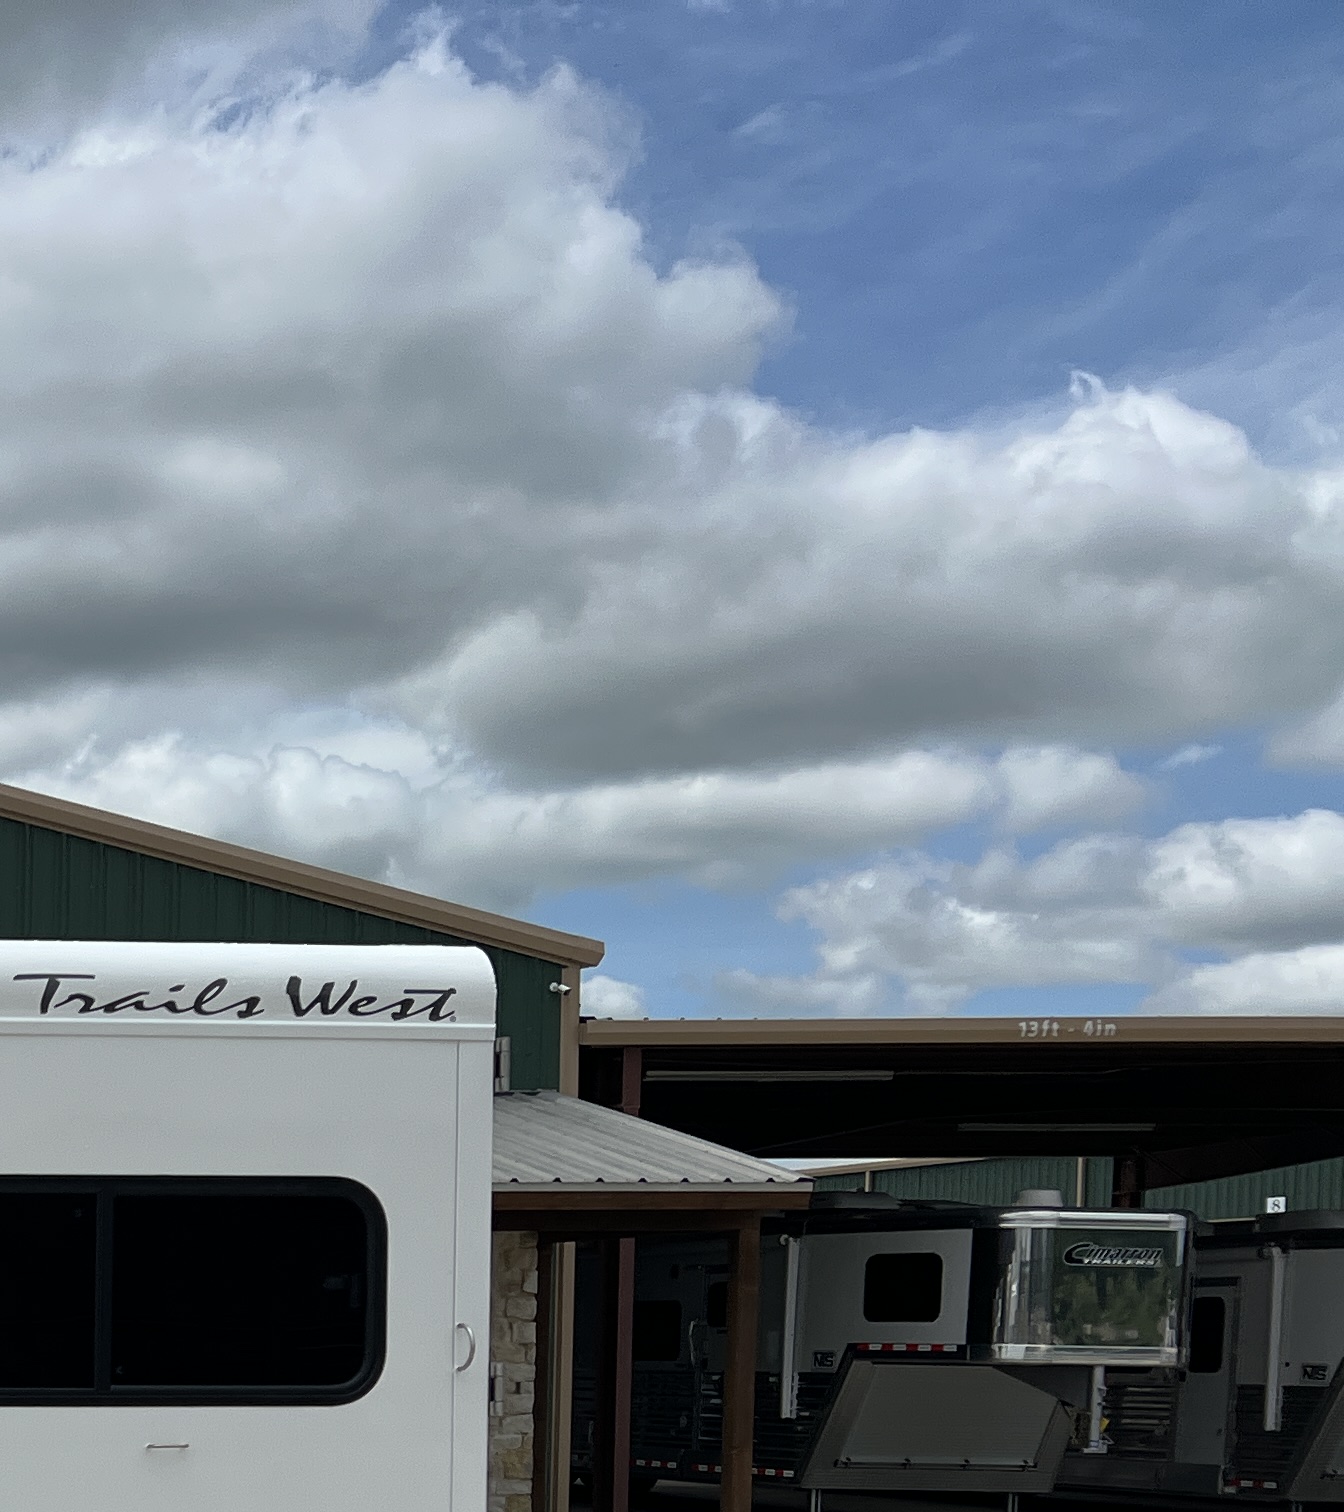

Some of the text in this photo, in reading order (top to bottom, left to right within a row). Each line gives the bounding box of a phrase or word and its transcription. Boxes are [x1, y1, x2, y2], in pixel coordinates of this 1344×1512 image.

[13, 973, 457, 1022] Trails West
[1018, 1019, 1060, 1037] 13ft
[1083, 1019, 1117, 1036] 4in
[1272, 1199, 1281, 1212] 8
[1063, 1241, 1163, 1265] Cimarron
